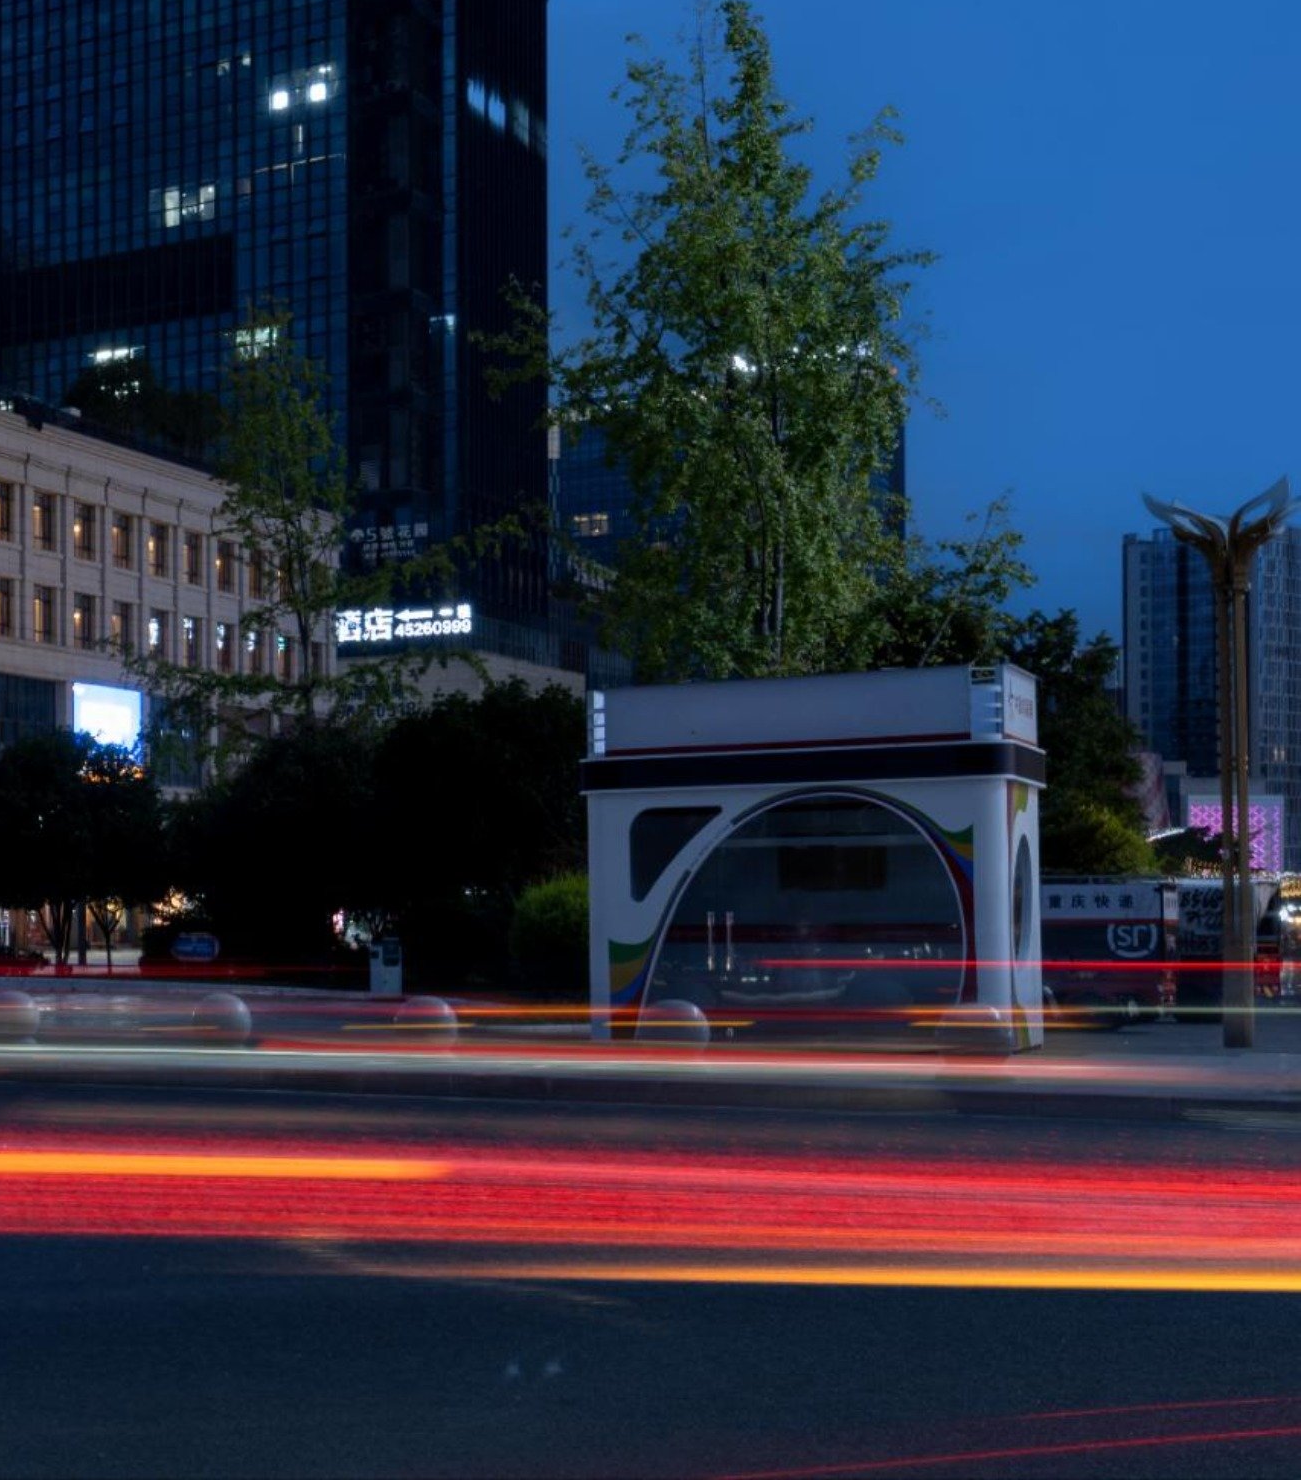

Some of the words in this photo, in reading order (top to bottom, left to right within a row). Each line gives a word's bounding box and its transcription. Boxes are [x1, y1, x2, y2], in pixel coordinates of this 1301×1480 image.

[394, 618, 472, 638] 45260999
[1049, 894, 1134, 909] 重庆快递
